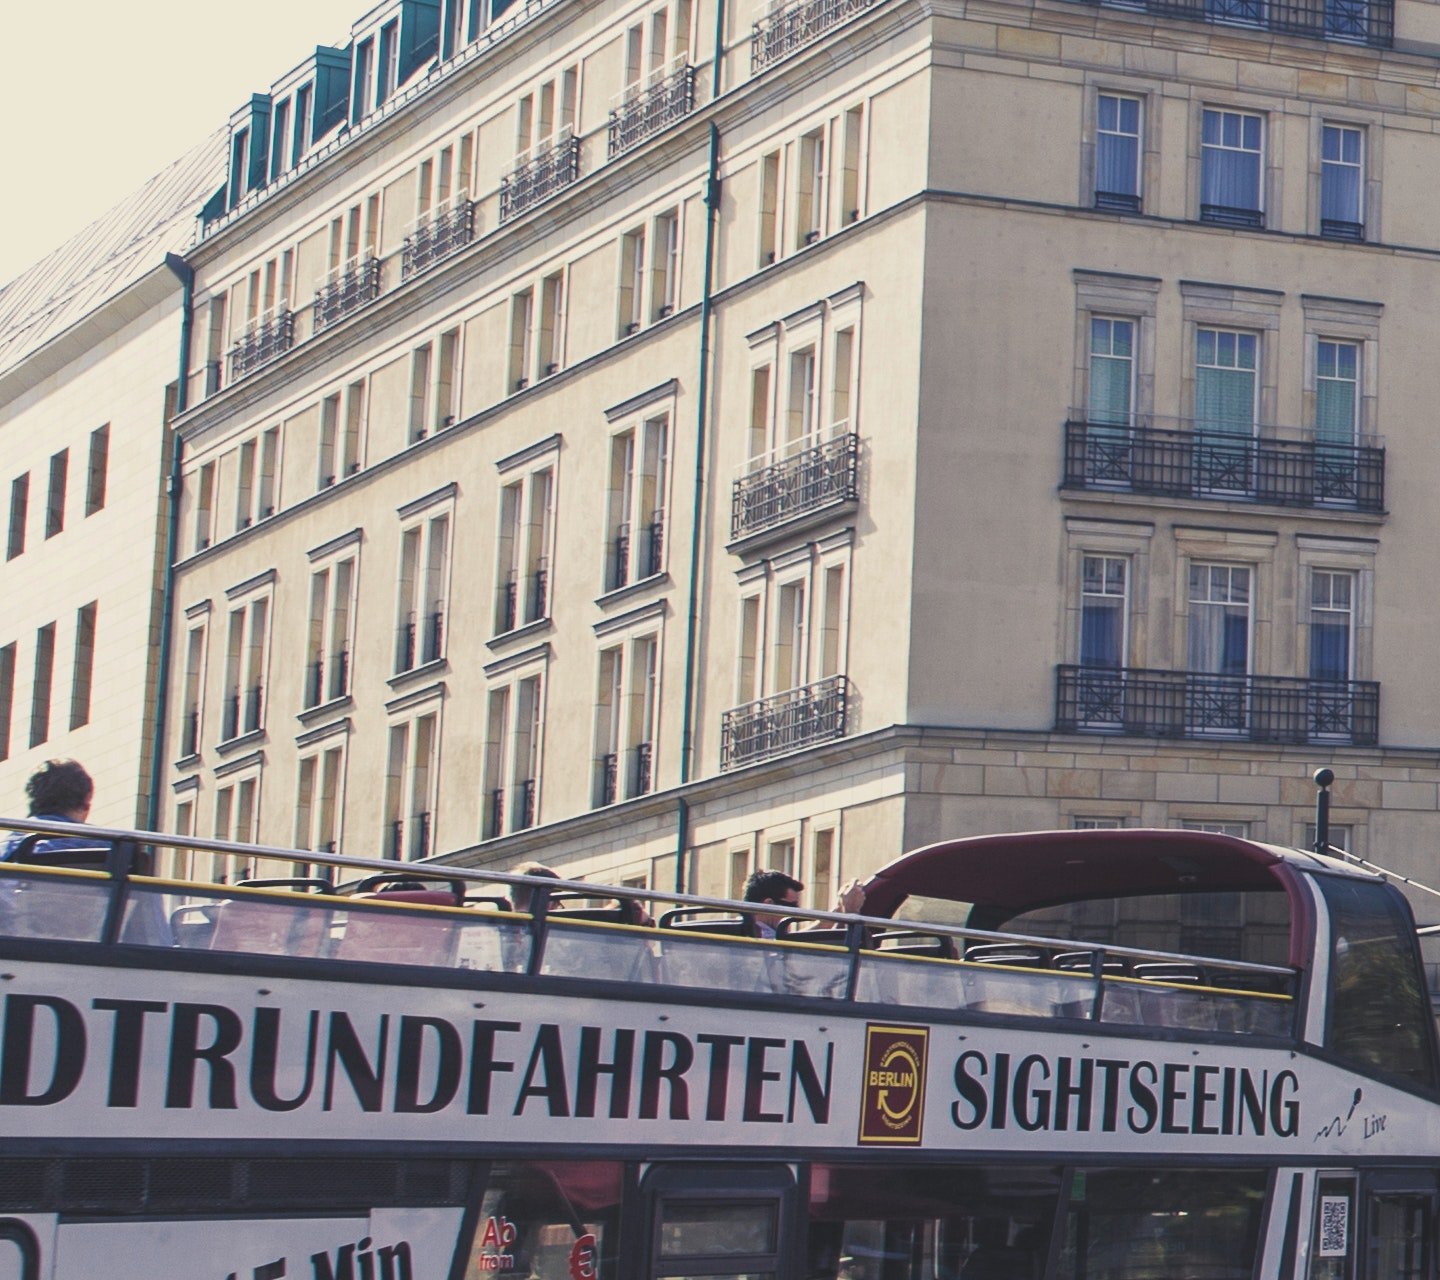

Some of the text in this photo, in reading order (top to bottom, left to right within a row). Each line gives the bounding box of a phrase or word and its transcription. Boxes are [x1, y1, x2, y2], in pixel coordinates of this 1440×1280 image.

[869, 1070, 914, 1089] BERLIN
[951, 1050, 1300, 1139] SIGHTSEEING
[1363, 1113, 1388, 1141] Live
[482, 1216, 518, 1247] Ab
[479, 1251, 514, 1271] from
